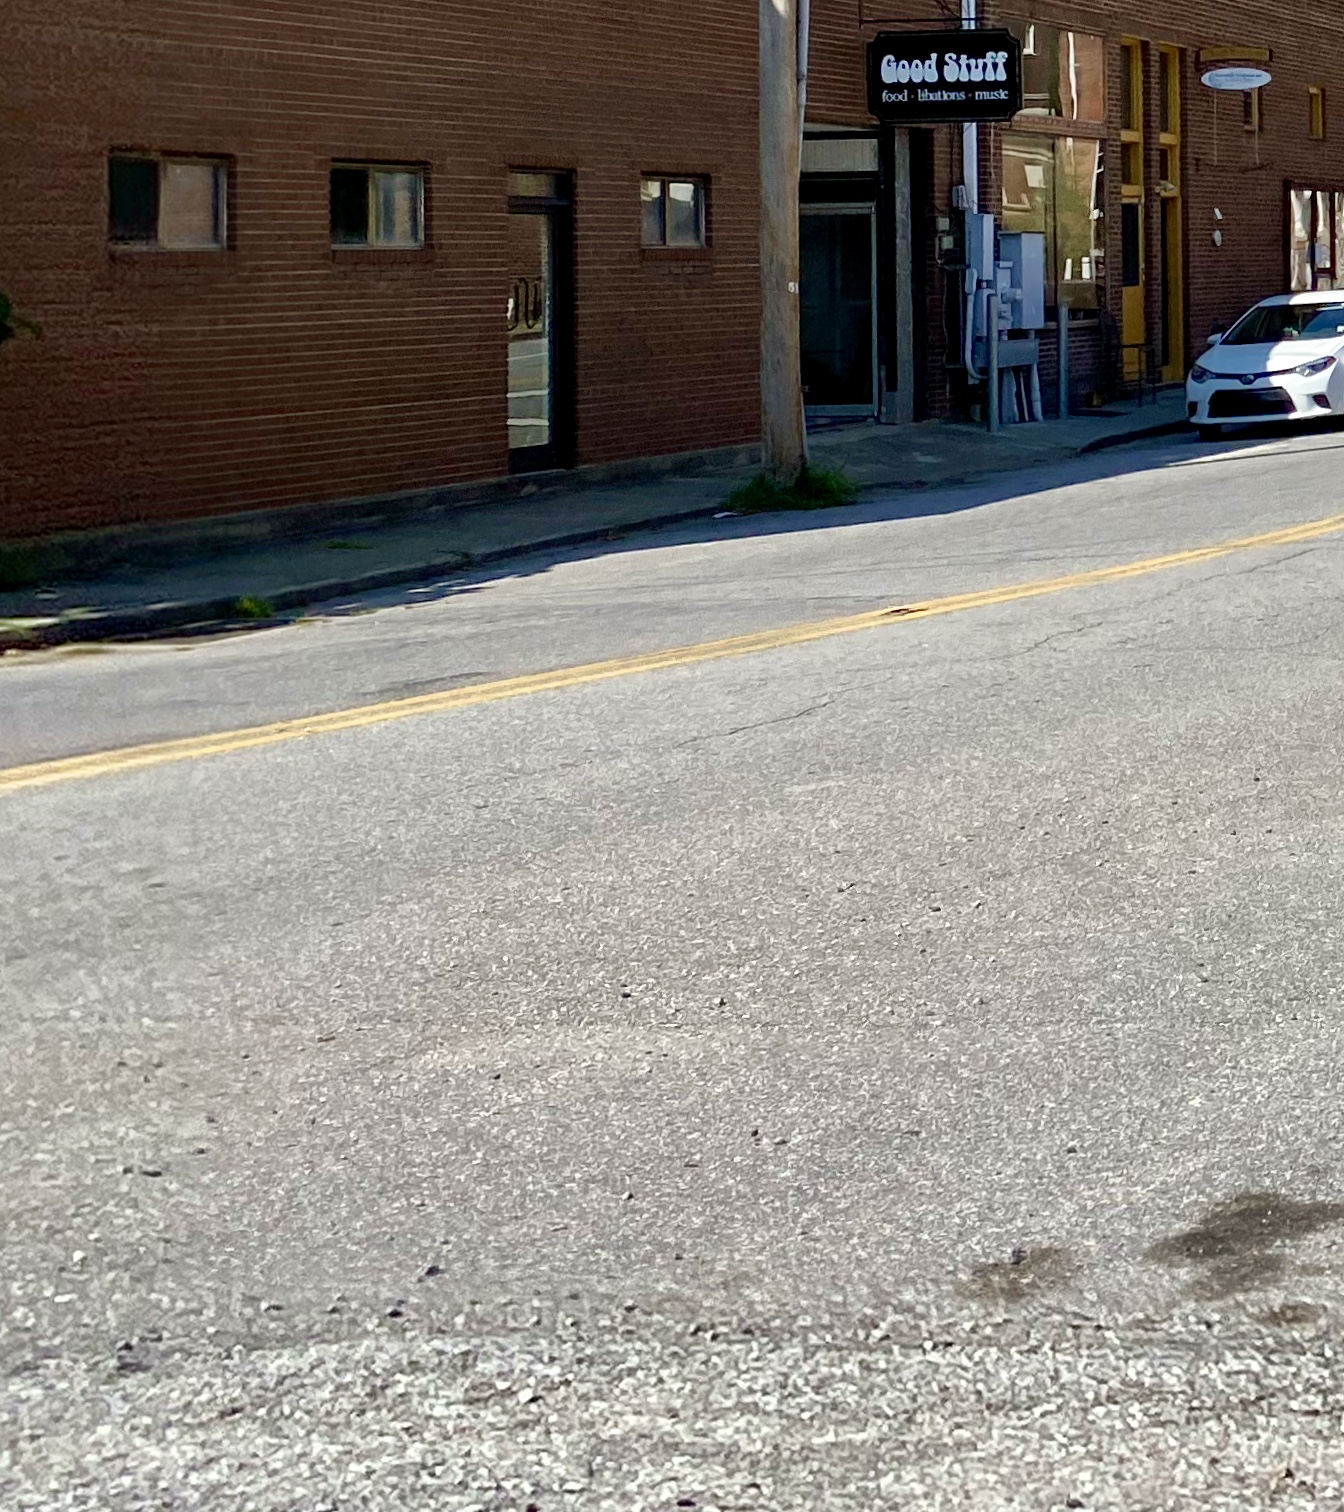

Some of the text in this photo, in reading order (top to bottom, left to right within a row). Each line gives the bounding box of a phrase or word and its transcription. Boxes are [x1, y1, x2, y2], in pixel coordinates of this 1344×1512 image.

[880, 51, 1008, 84] Good Stuff
[881, 88, 1009, 102] food libations music
